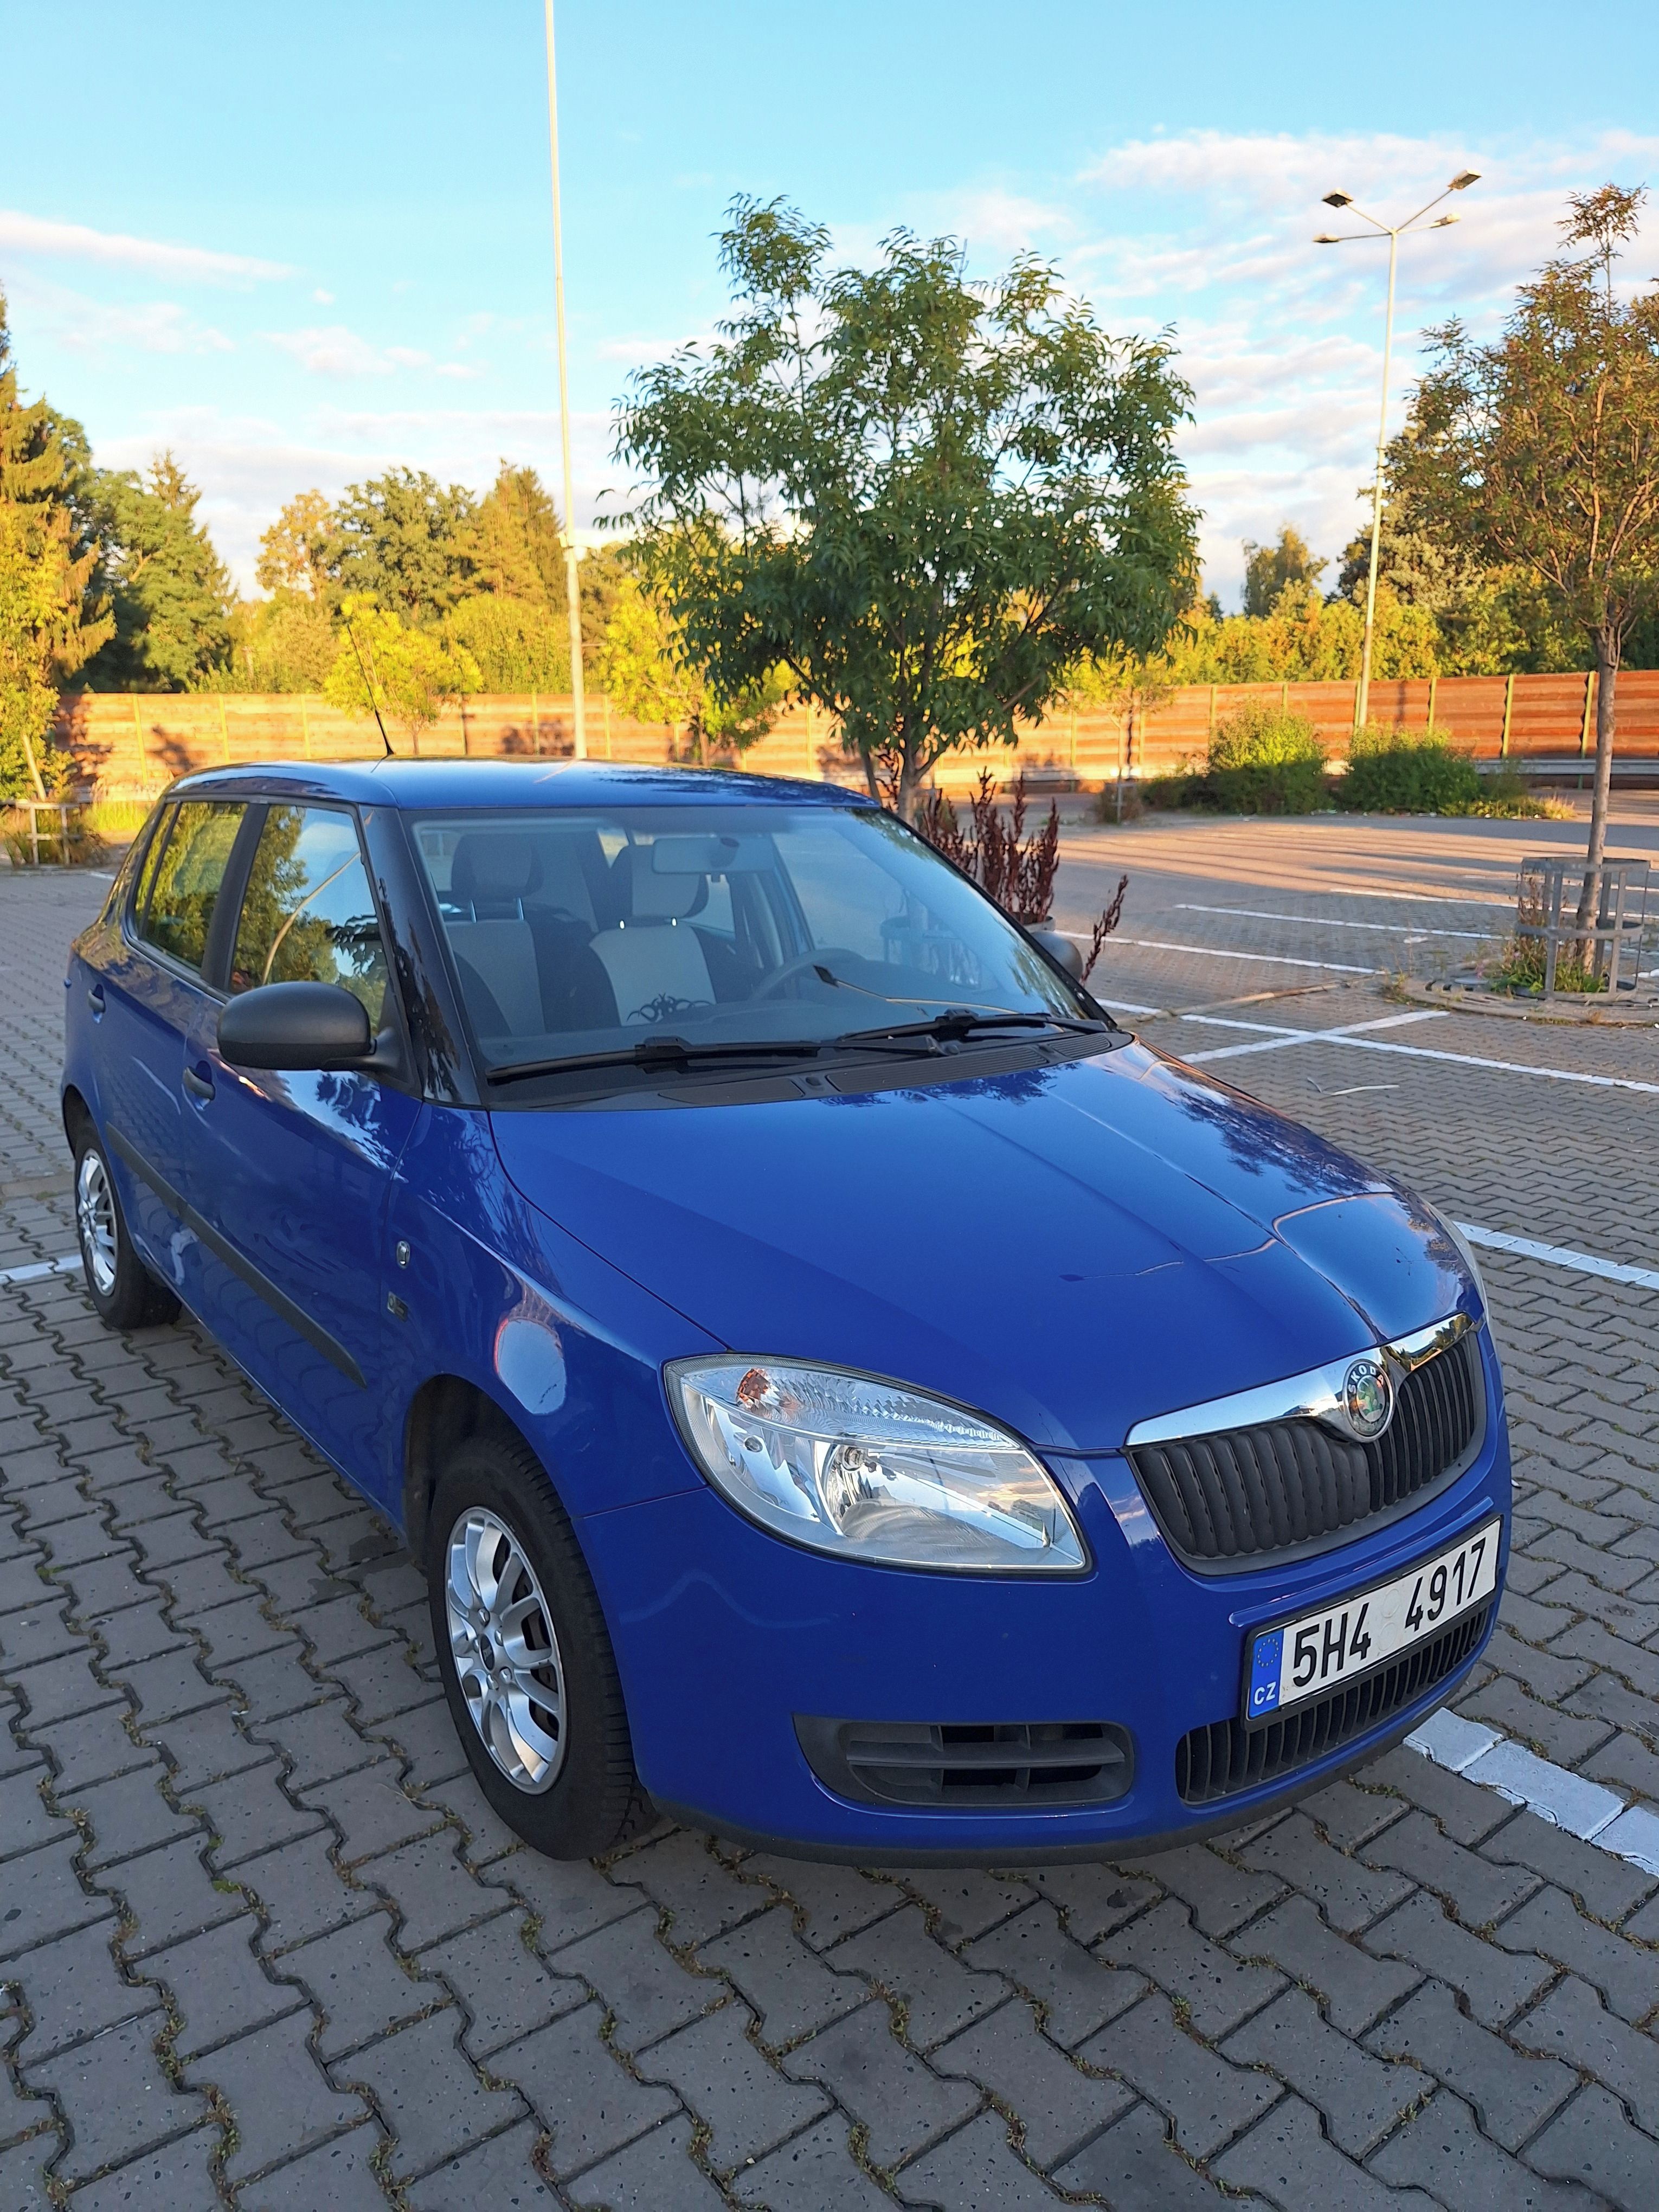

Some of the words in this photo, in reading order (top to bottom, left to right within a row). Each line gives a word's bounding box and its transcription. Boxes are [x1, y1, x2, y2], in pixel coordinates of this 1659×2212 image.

[1293, 1603, 1372, 1687] 5H4
[1404, 1537, 1486, 1632] 4917
[1254, 1682, 1276, 1705] CZ
